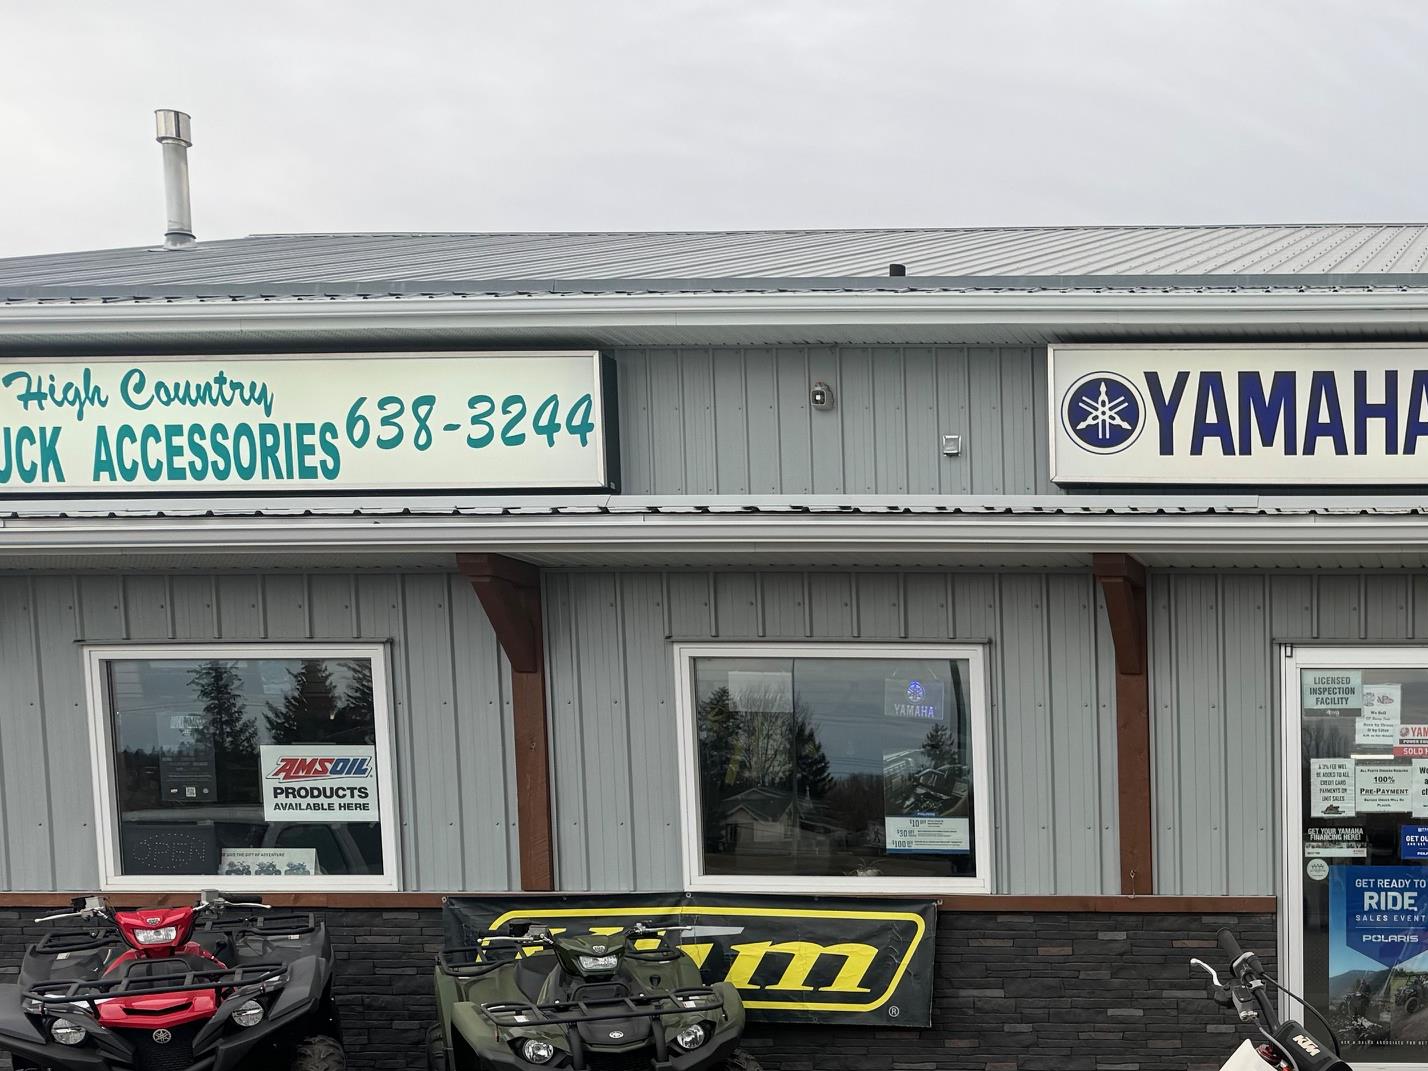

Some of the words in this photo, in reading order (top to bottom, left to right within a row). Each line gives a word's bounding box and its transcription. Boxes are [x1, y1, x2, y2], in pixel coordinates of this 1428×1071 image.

[1, 368, 109, 422] High
[119, 367, 275, 419] Country
[345, 393, 596, 452] 638-3244
[92, 421, 342, 483] ACCESSORIES
[1313, 676, 1351, 685] LICENSED
[1309, 687, 1356, 696] INSPECTION
[1315, 697, 1349, 705] FACILITY
[893, 703, 935, 719] YAMAHA
[1403, 747, 1424, 756] SOLD
[270, 757, 371, 780] AMSOIL
[272, 786, 370, 800] PRODUCTS
[1359, 787, 1409, 795] PRE-PAYMENT
[273, 802, 335, 812] AVAILABLE
[338, 802, 370, 811] HERE
[1355, 878, 1376, 889] GET
[1377, 878, 1411, 889] READY
[1413, 878, 1427, 889] TO
[1363, 891, 1418, 912] RIDE
[1355, 914, 1388, 922] SALES
[1393, 914, 1426, 922] EVENT
[1362, 934, 1419, 943] POLARIS
[1292, 1034, 1321, 1057] KTM
